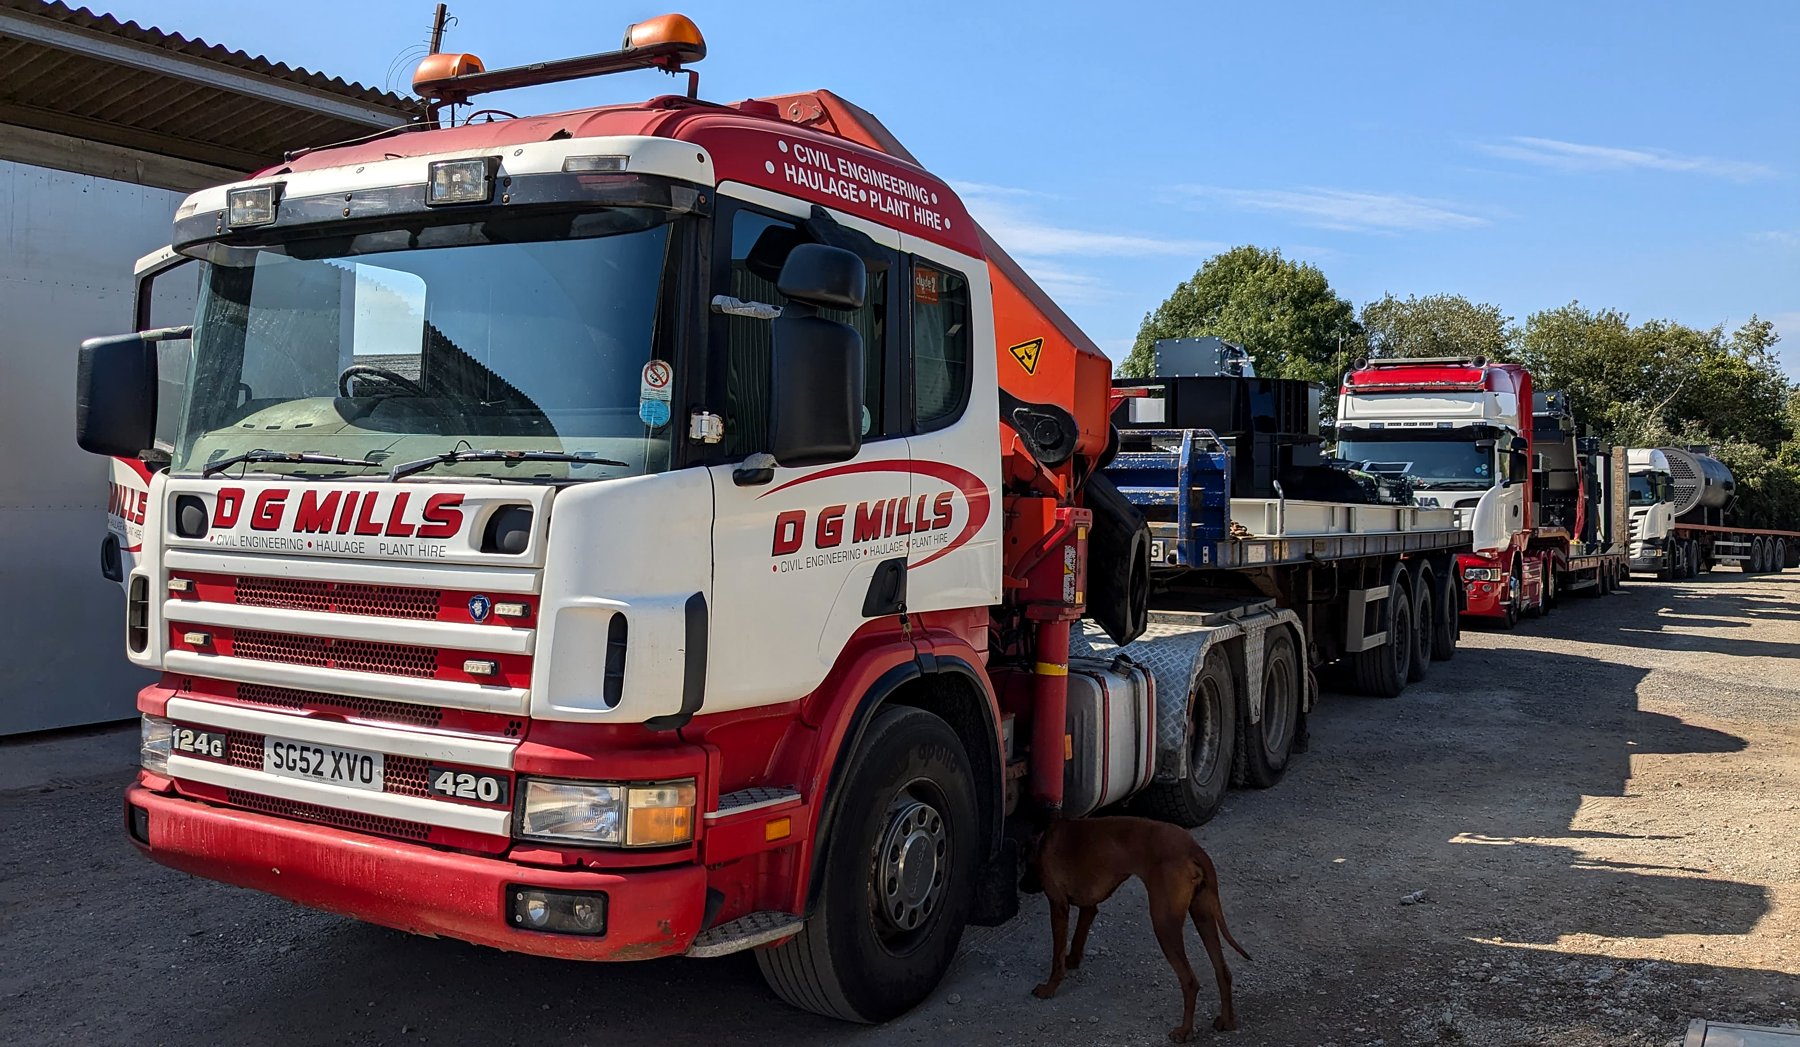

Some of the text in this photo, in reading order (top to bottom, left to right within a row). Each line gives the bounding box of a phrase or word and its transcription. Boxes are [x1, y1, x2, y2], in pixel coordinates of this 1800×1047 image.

[784, 162, 942, 231] HAULAGE PLANT HIRE
[793, 143, 930, 205] CIVIL ENGINEERING
[211, 487, 466, 539] D G MILLS
[771, 490, 955, 557] D G MILLS
[216, 534, 447, 558] CIVIL ENGINEERING HAULAGE PLANT HIRE
[780, 532, 948, 573] CIVIL ENGINEERING HAULAGE PLANT HIRE
[273, 741, 374, 785] SG52 XVO
[434, 770, 500, 802] 420
